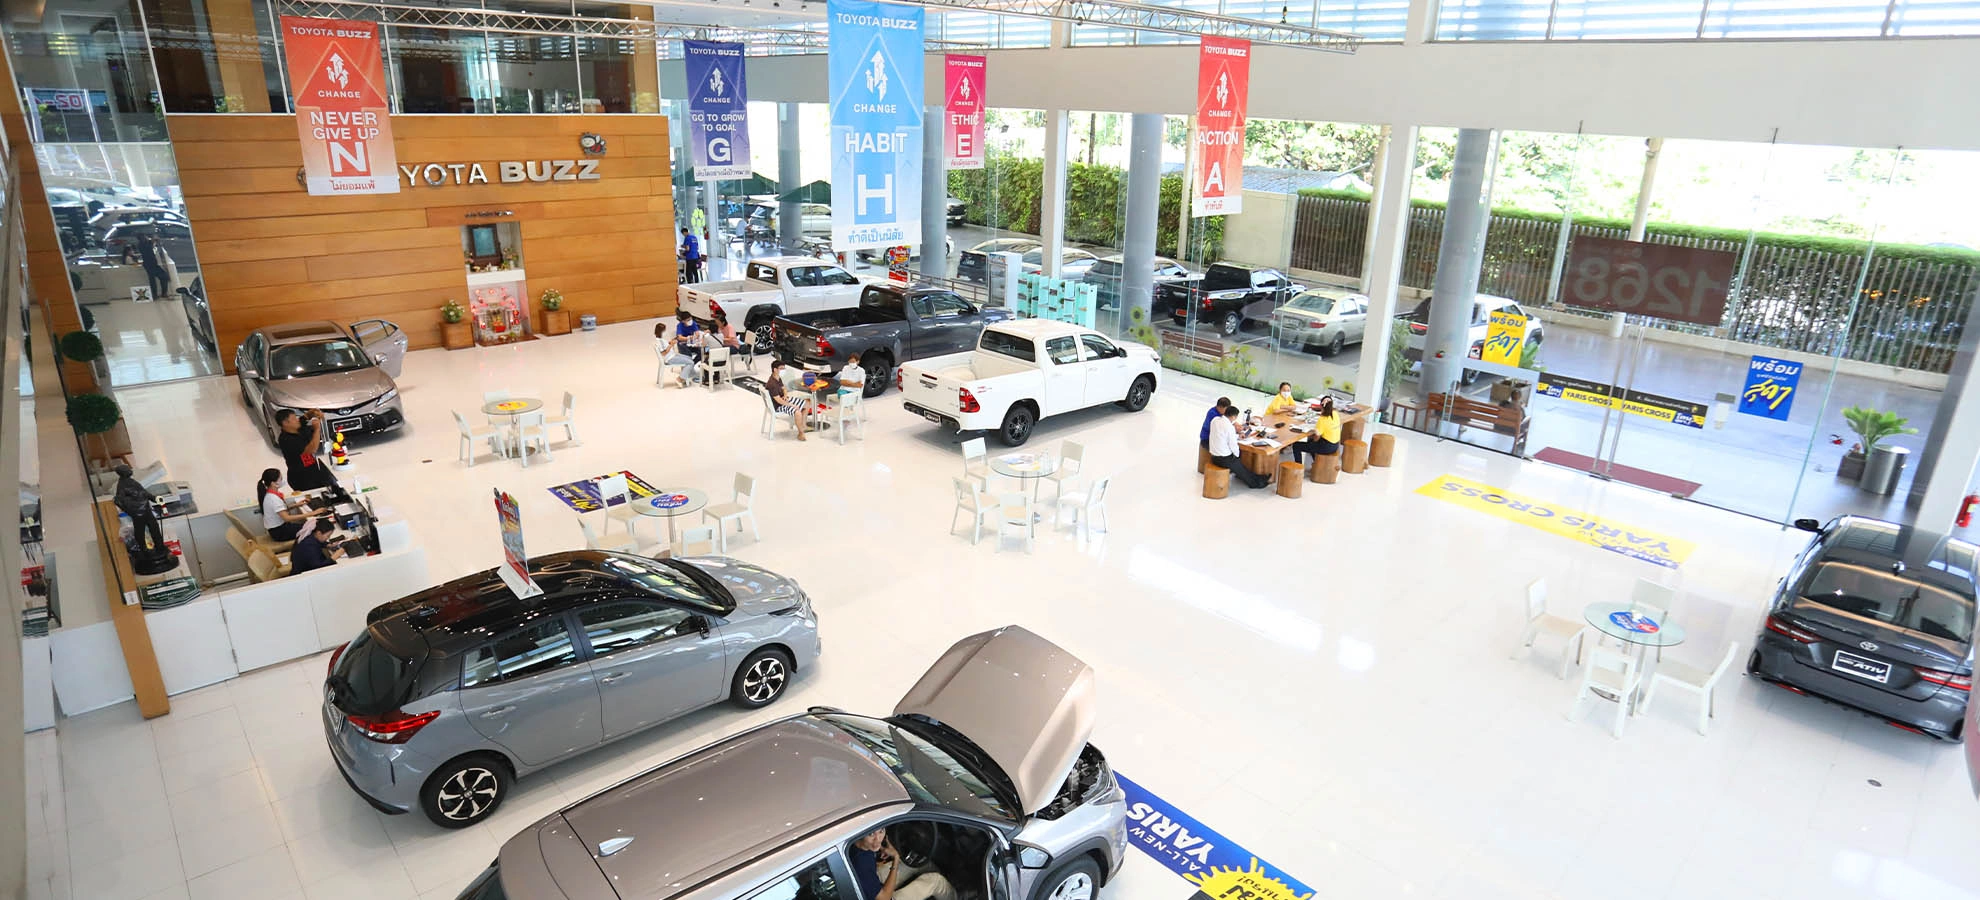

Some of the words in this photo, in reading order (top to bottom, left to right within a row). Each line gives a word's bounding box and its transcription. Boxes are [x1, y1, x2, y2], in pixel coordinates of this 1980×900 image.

[836, 13, 880, 26] TOYOTA
[882, 18, 918, 30] BUZZ
[291, 27, 335, 37] TOYOTA
[336, 29, 372, 39] BUZZ
[689, 47, 716, 55] TOYOTA
[1204, 45, 1227, 55] TOYOTA
[1227, 48, 1247, 57] BUZZ
[318, 90, 361, 98] CHANGE
[853, 103, 897, 114] CHANGE
[1208, 109, 1232, 117] CHANGE
[310, 111, 378, 125] NEVER
[691, 113, 704, 121] GO
[706, 113, 718, 121] TO
[721, 113, 745, 122] GROW
[951, 114, 979, 126] ETHIC
[313, 127, 352, 140] GIVE
[357, 127, 379, 140] UP
[702, 123, 713, 131] TO
[715, 124, 737, 132] GOAL
[845, 132, 908, 153] HABIT
[957, 133, 971, 156] E
[1199, 131, 1239, 146] ACTION
[329, 141, 367, 173] N
[708, 137, 731, 162] G
[398, 163, 488, 187] YOTA
[500, 159, 600, 183] BUZZ
[1203, 161, 1225, 193] A
[857, 173, 893, 216] H
[1751, 360, 1800, 376] พร้อม
[1566, 391, 1587, 401] YARIS
[1588, 396, 1613, 407] CROSS
[1644, 408, 1671, 420] CROSS
[1441, 482, 1556, 518] CROSS
[1561, 516, 1670, 553] YARIS
[1853, 663, 1887, 674] ATIV
[1127, 802, 1215, 865] YARIS
[1130, 826, 1201, 872] ALL-NEW
